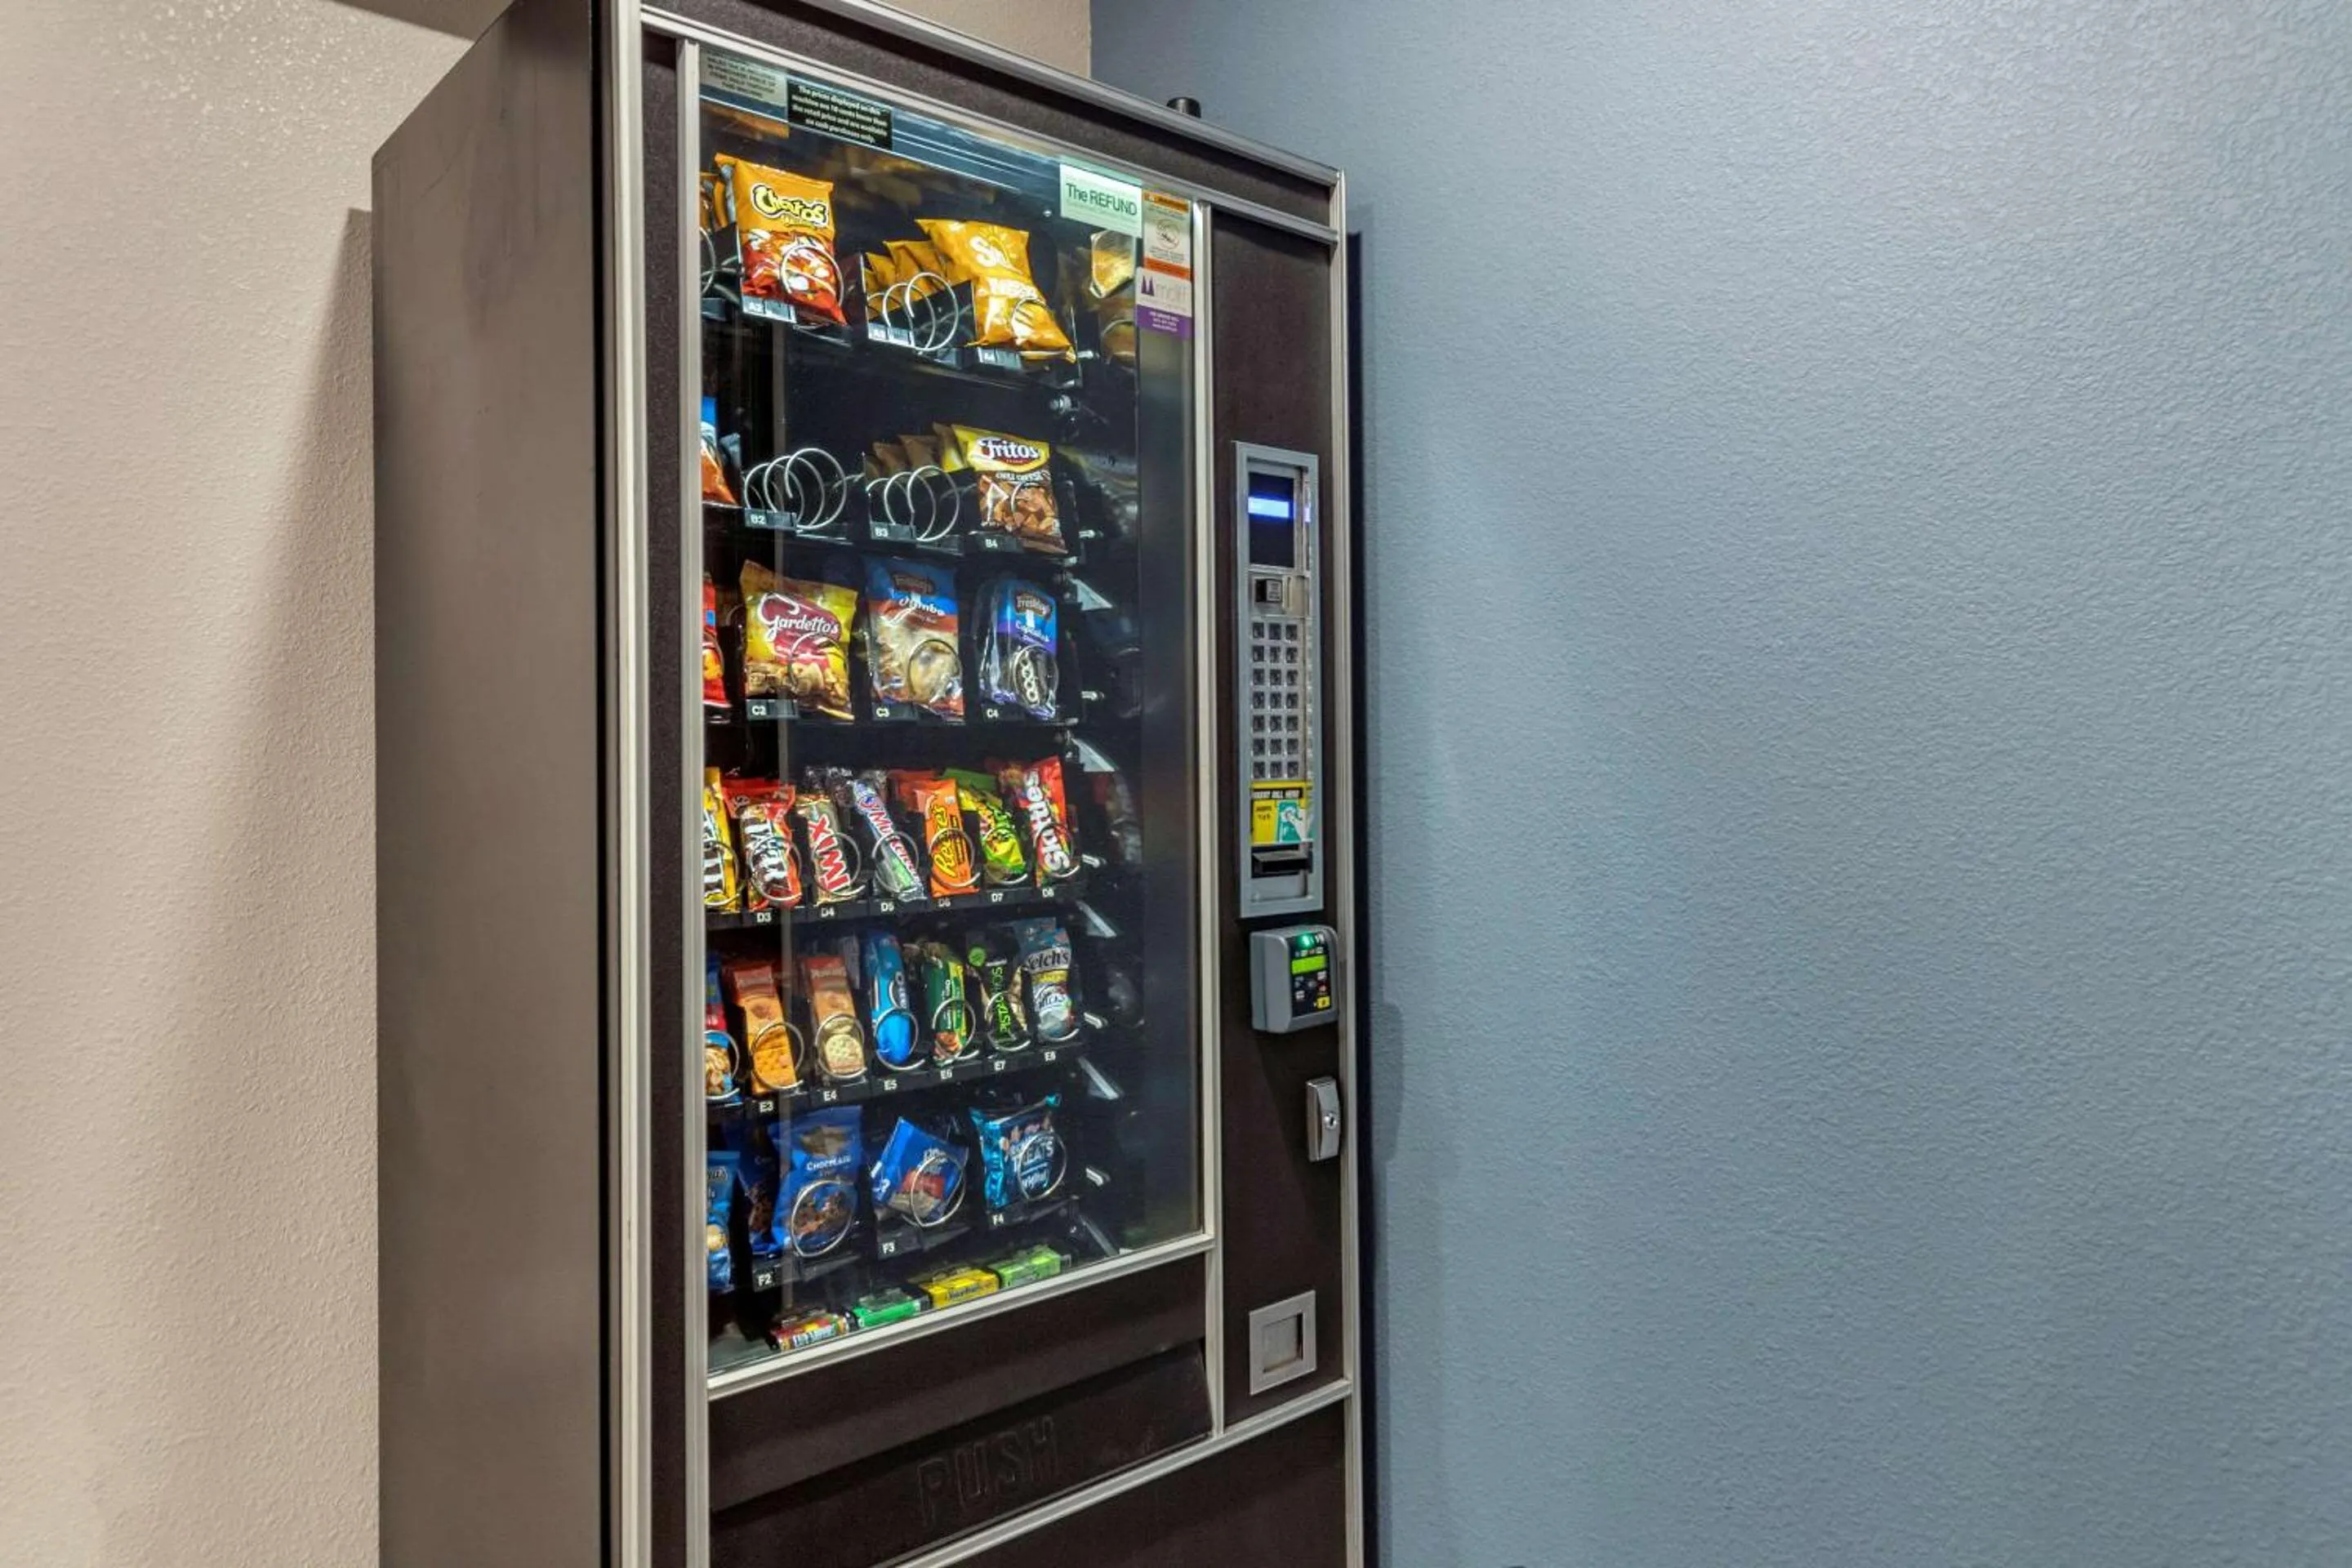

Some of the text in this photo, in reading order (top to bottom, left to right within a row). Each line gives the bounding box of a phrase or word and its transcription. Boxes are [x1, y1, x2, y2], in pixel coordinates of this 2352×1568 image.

[1066, 182, 1089, 203] The
[1089, 189, 1138, 216] REFUND
[978, 436, 1039, 459] Fritos
[758, 591, 838, 642] Gardetto's
[751, 705, 766, 716] C2
[876, 707, 889, 718] C3
[987, 708, 999, 719] C4
[808, 813, 850, 893] TWIX
[991, 893, 1004, 902] D7
[1042, 888, 1054, 898] D8
[880, 902, 894, 912] D5
[938, 898, 951, 908] D6
[756, 911, 772, 923] D3
[821, 906, 835, 917] D4
[1025, 950, 1069, 972] elch's
[1045, 1053, 1057, 1062] E8
[993, 1062, 1005, 1071] E7
[940, 1071, 952, 1080] E6
[884, 1080, 898, 1090] E5
[823, 1092, 837, 1102] E4
[760, 1102, 773, 1113] E3
[992, 1214, 1004, 1225] F4
[882, 1243, 895, 1254] F3
[758, 1275, 772, 1286] F2
[915, 1414, 1061, 1532] PUSH
